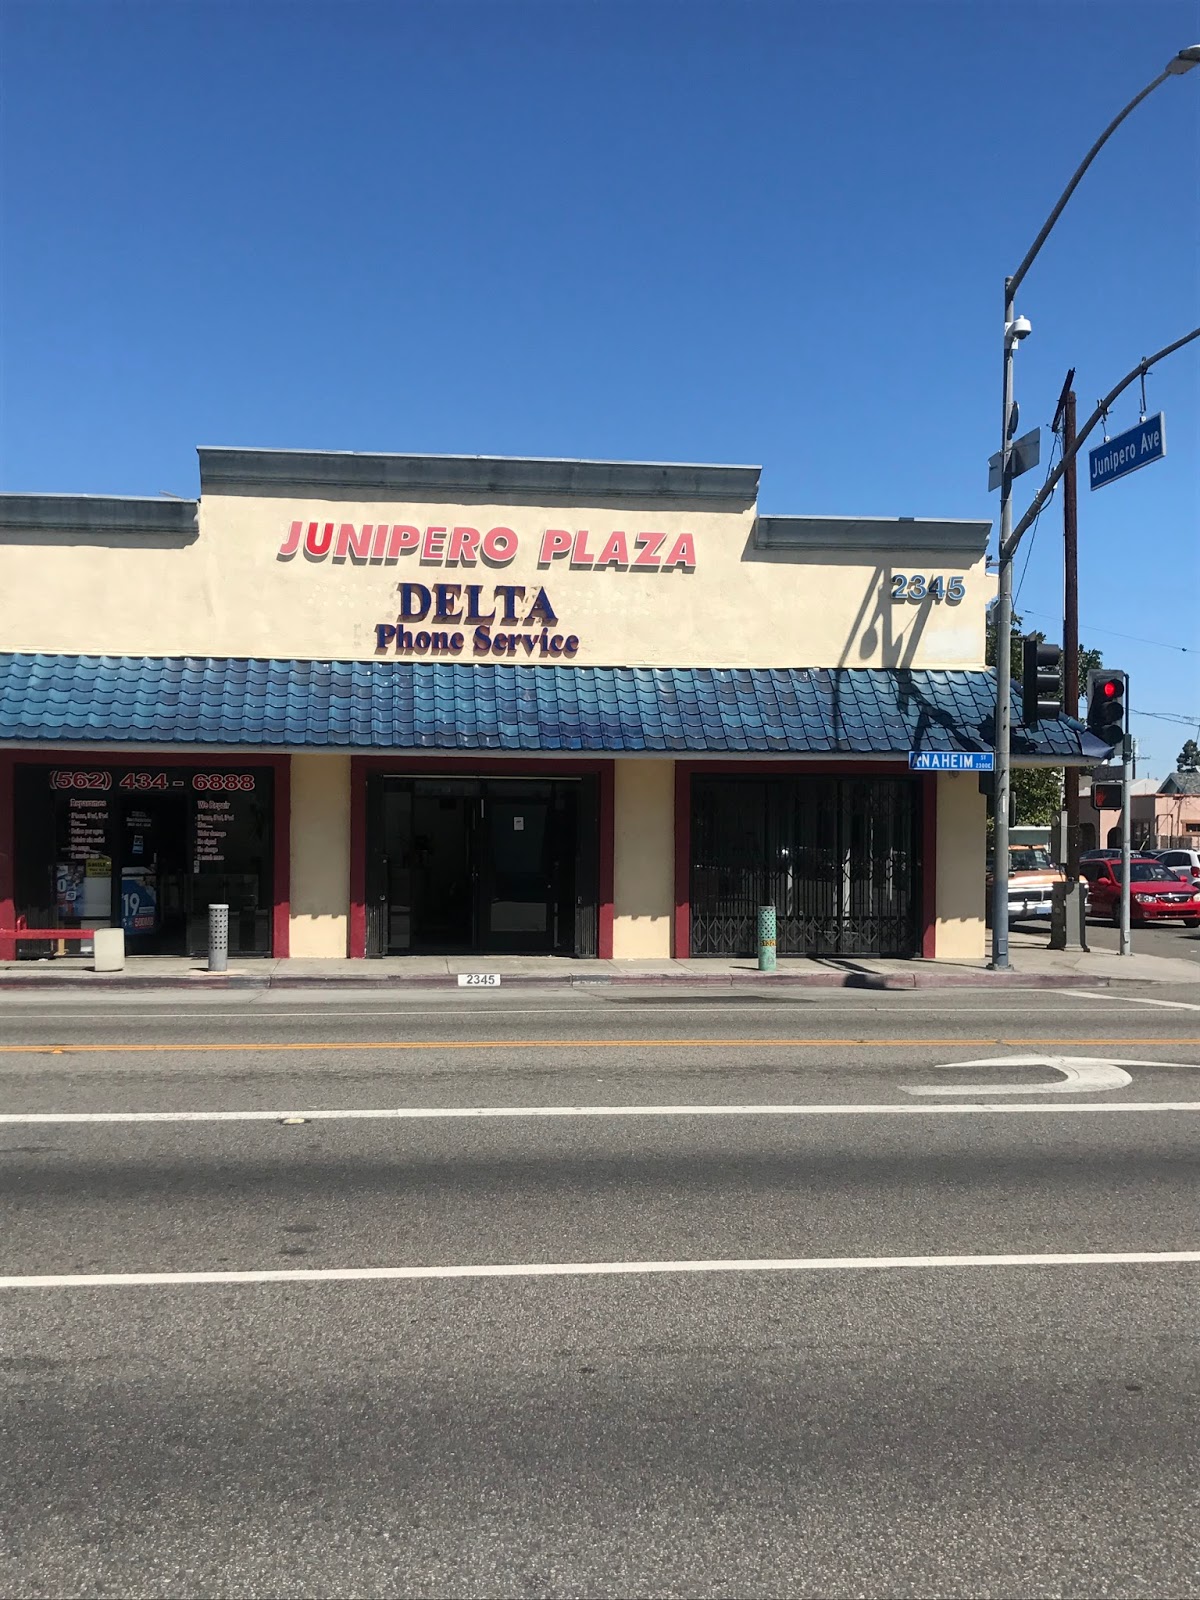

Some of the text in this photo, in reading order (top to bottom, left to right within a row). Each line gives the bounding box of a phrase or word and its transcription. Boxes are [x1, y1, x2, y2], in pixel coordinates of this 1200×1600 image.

[1092, 430, 1160, 479] Junipero Ave
[278, 521, 697, 570] JUNIPERO PLAZA
[891, 574, 966, 601] 2345
[397, 582, 558, 623] DELTA
[375, 623, 579, 656] Phone Service
[911, 753, 974, 769] ANAHEIM
[50, 771, 112, 791] (562)
[119, 773, 168, 790] 434
[192, 774, 256, 791] 6888
[197, 800, 231, 811] We Repair
[466, 974, 495, 985] 2345
